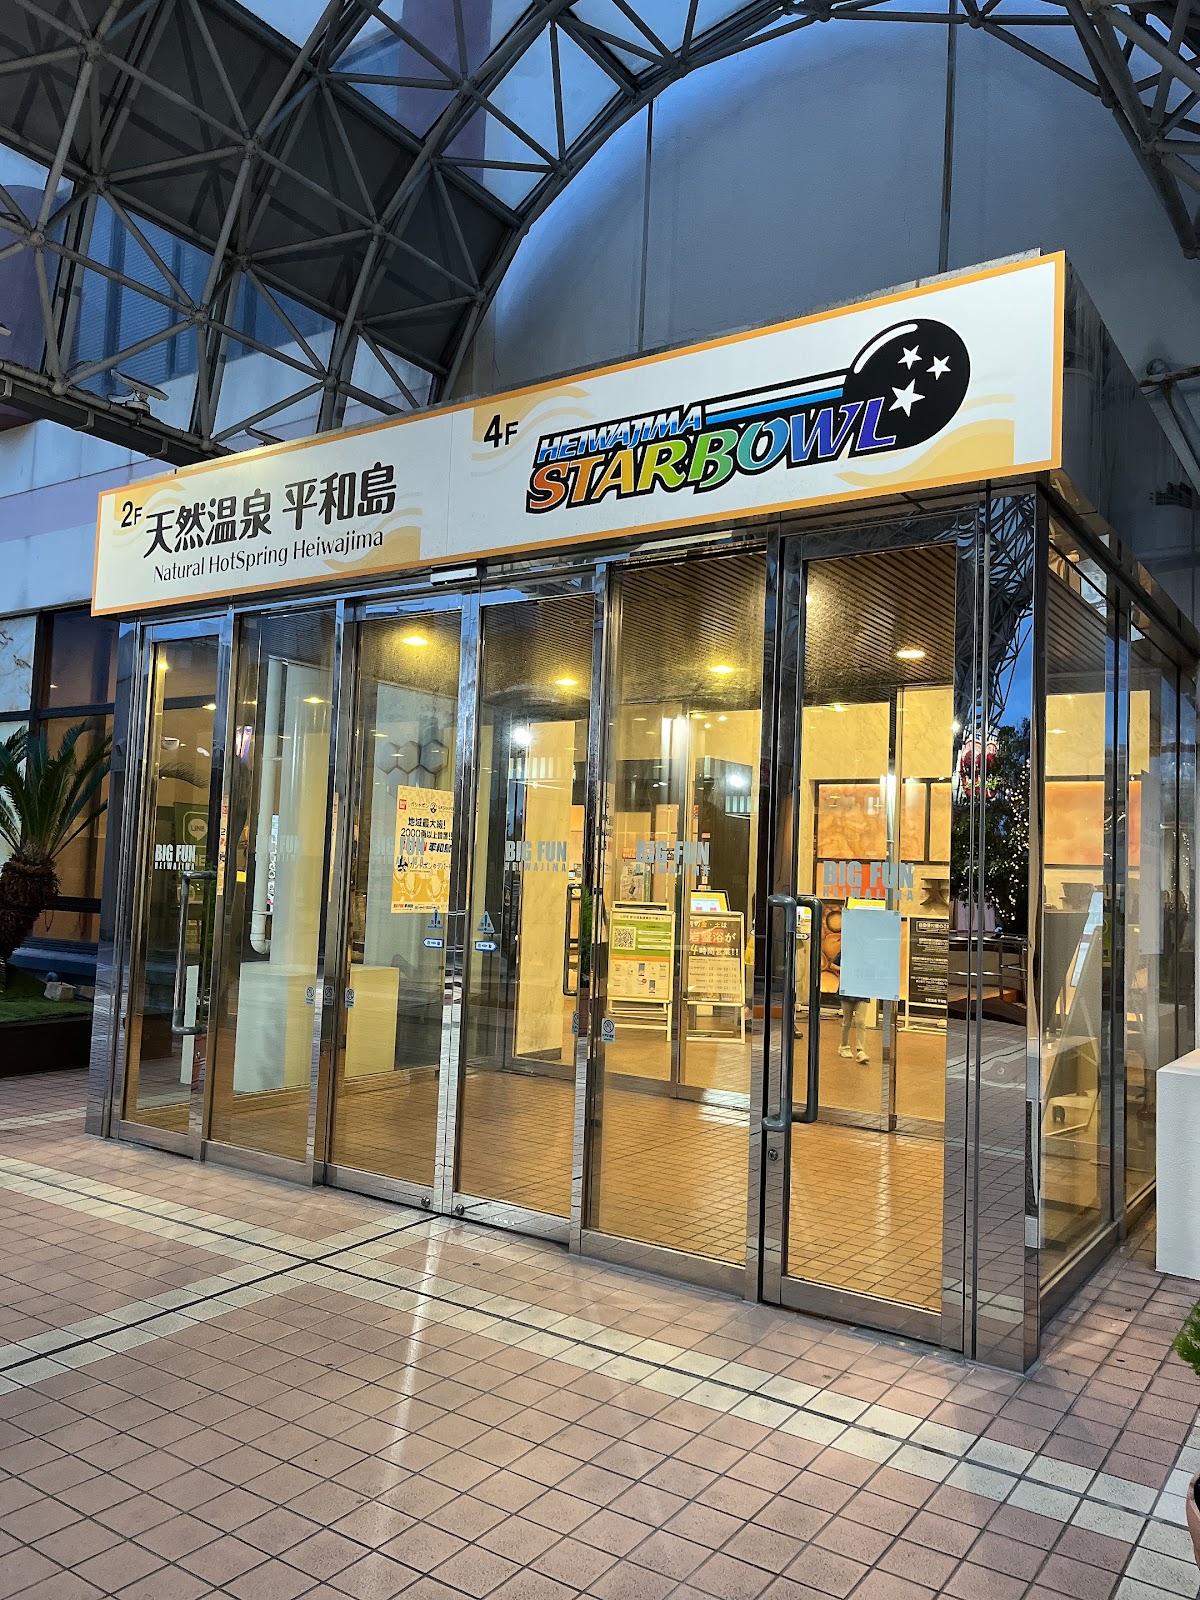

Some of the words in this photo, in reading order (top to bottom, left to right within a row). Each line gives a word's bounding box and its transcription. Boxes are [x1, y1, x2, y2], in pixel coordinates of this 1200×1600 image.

[484, 414, 519, 449] 4F
[538, 404, 702, 463] HEIWAJIMA
[527, 398, 897, 512] STARBOWL
[120, 500, 143, 529] 2F
[143, 488, 272, 558] 天然温泉
[282, 461, 397, 531] 平和島
[153, 558, 205, 582] Natural
[209, 544, 288, 572] HotSpring
[293, 529, 383, 560] Heiwajima
[190, 824, 206, 832] LINE
[155, 844, 173, 862] BIG
[176, 844, 196, 862] FUN
[505, 840, 532, 862] BIG
[537, 840, 567, 862] FUN
[635, 840, 668, 863] BIG
[674, 840, 710, 865] FUN
[154, 862, 196, 871] HEIWAJIMA
[823, 860, 862, 887] BIG
[870, 861, 914, 889] FUN
[688, 943, 739, 956] 4時間営業!!
[689, 931, 737, 944] 岩盤浴が
